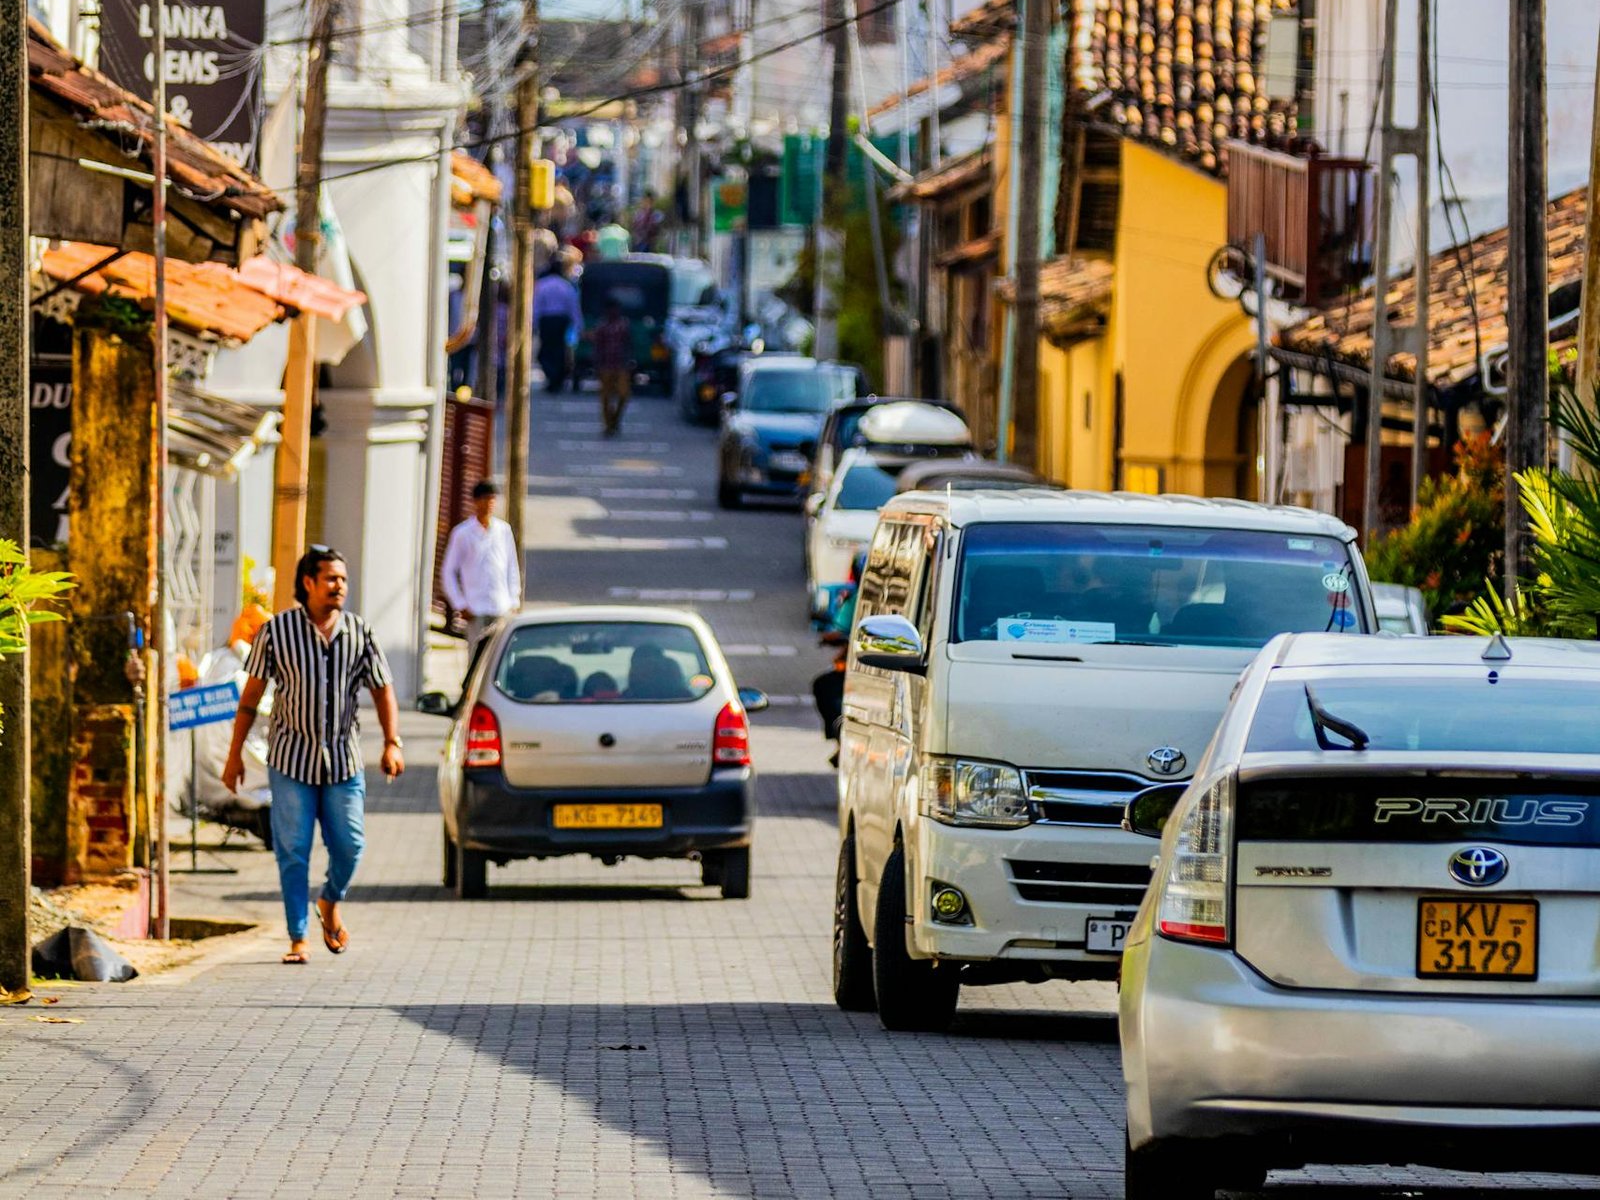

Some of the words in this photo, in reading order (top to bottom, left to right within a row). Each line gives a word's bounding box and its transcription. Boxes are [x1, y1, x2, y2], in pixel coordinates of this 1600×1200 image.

[1374, 798, 1590, 826] PRIUS
[1455, 903, 1502, 937] KV
[1433, 938, 1523, 975] 3179
